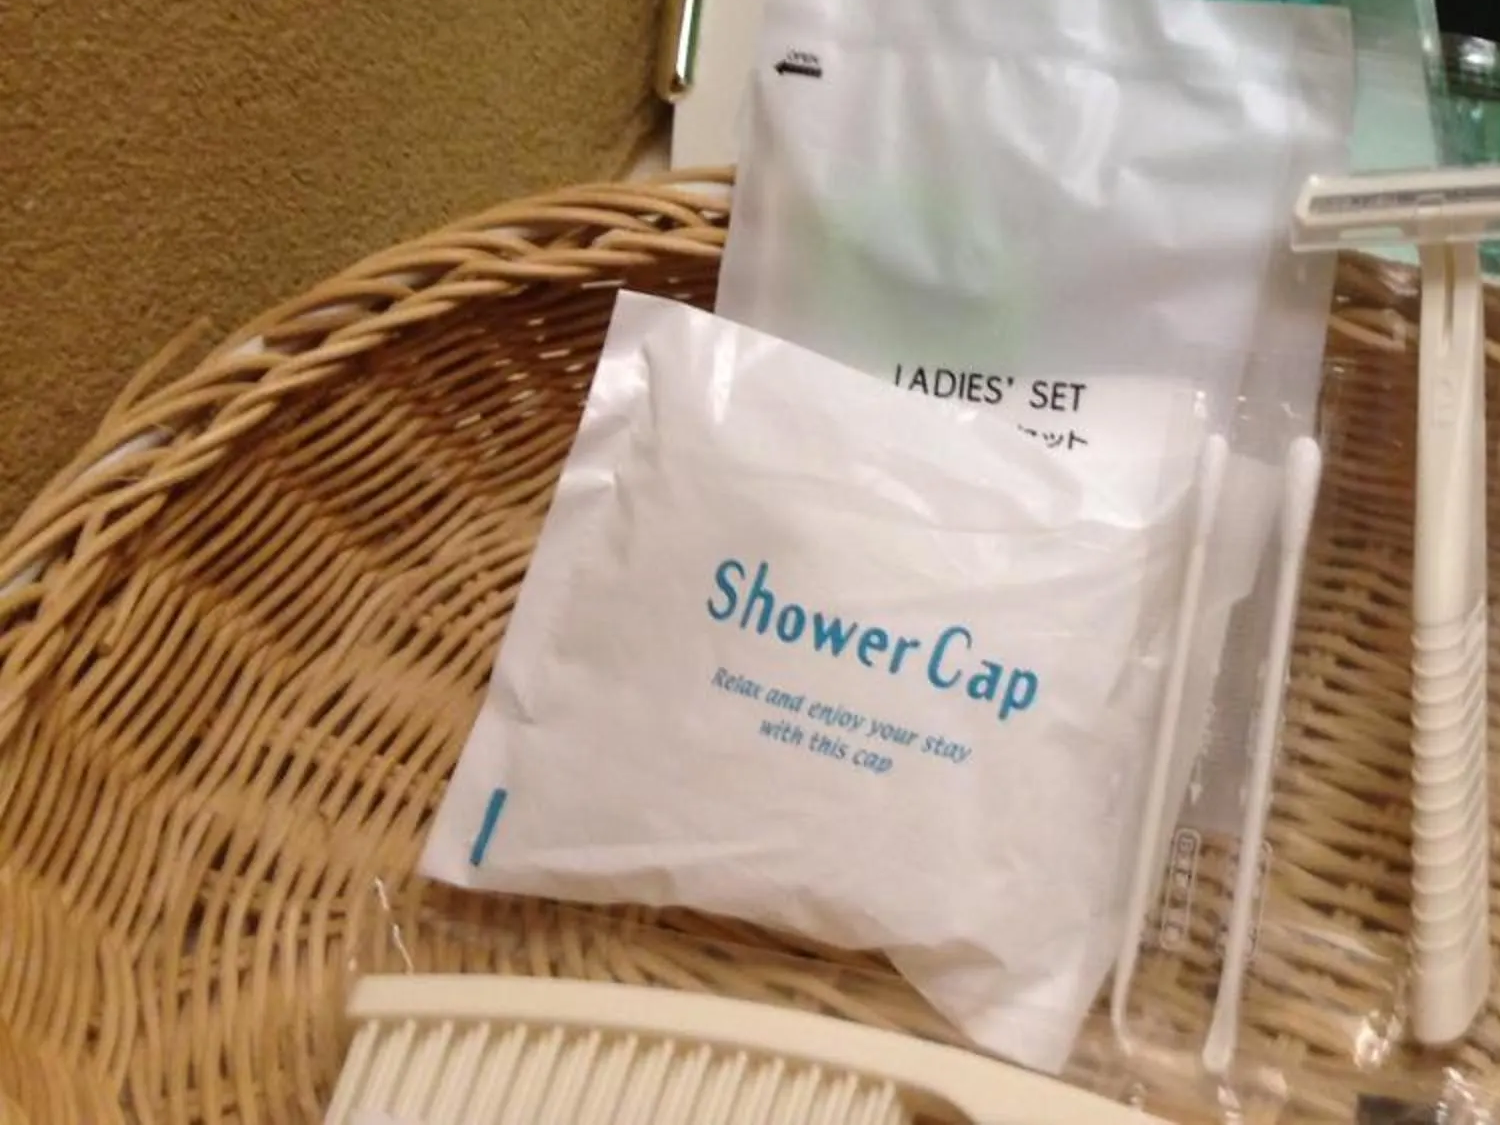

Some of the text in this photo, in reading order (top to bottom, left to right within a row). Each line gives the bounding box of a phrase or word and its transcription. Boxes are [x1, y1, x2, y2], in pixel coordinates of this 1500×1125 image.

[1029, 379, 1088, 412] SET
[707, 559, 1038, 721] Shower Cap
[711, 667, 973, 764] Relax and enjoy your stay
[759, 719, 893, 774] with this cap
